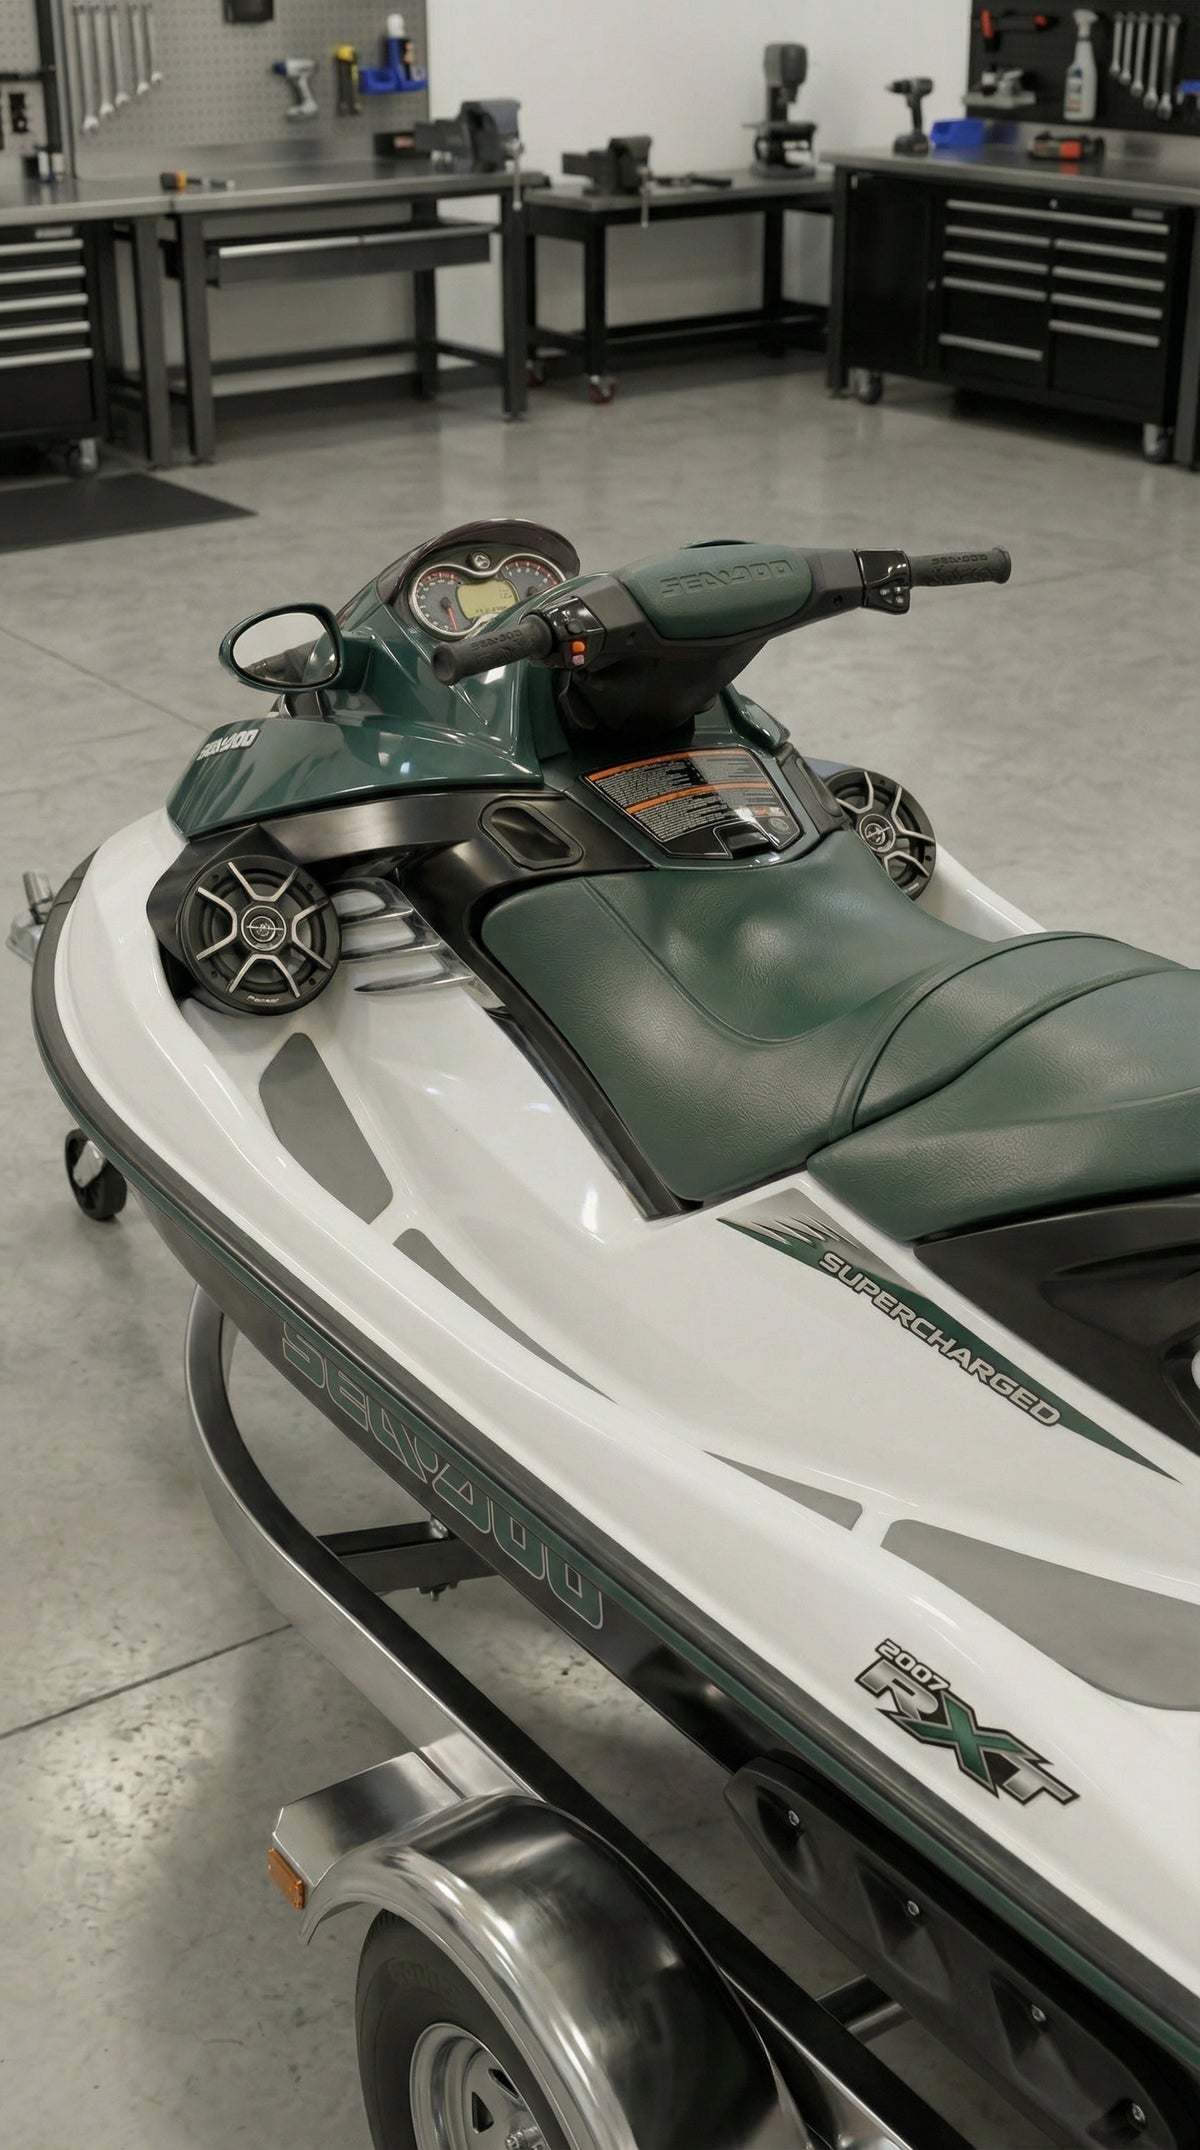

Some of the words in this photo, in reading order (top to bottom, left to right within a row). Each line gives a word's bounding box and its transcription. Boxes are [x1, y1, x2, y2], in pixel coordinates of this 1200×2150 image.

[818, 1251, 1063, 1427] SUPERCHARGED
[854, 1656, 1081, 1807] RXT
[875, 1638, 951, 1692] 2007
